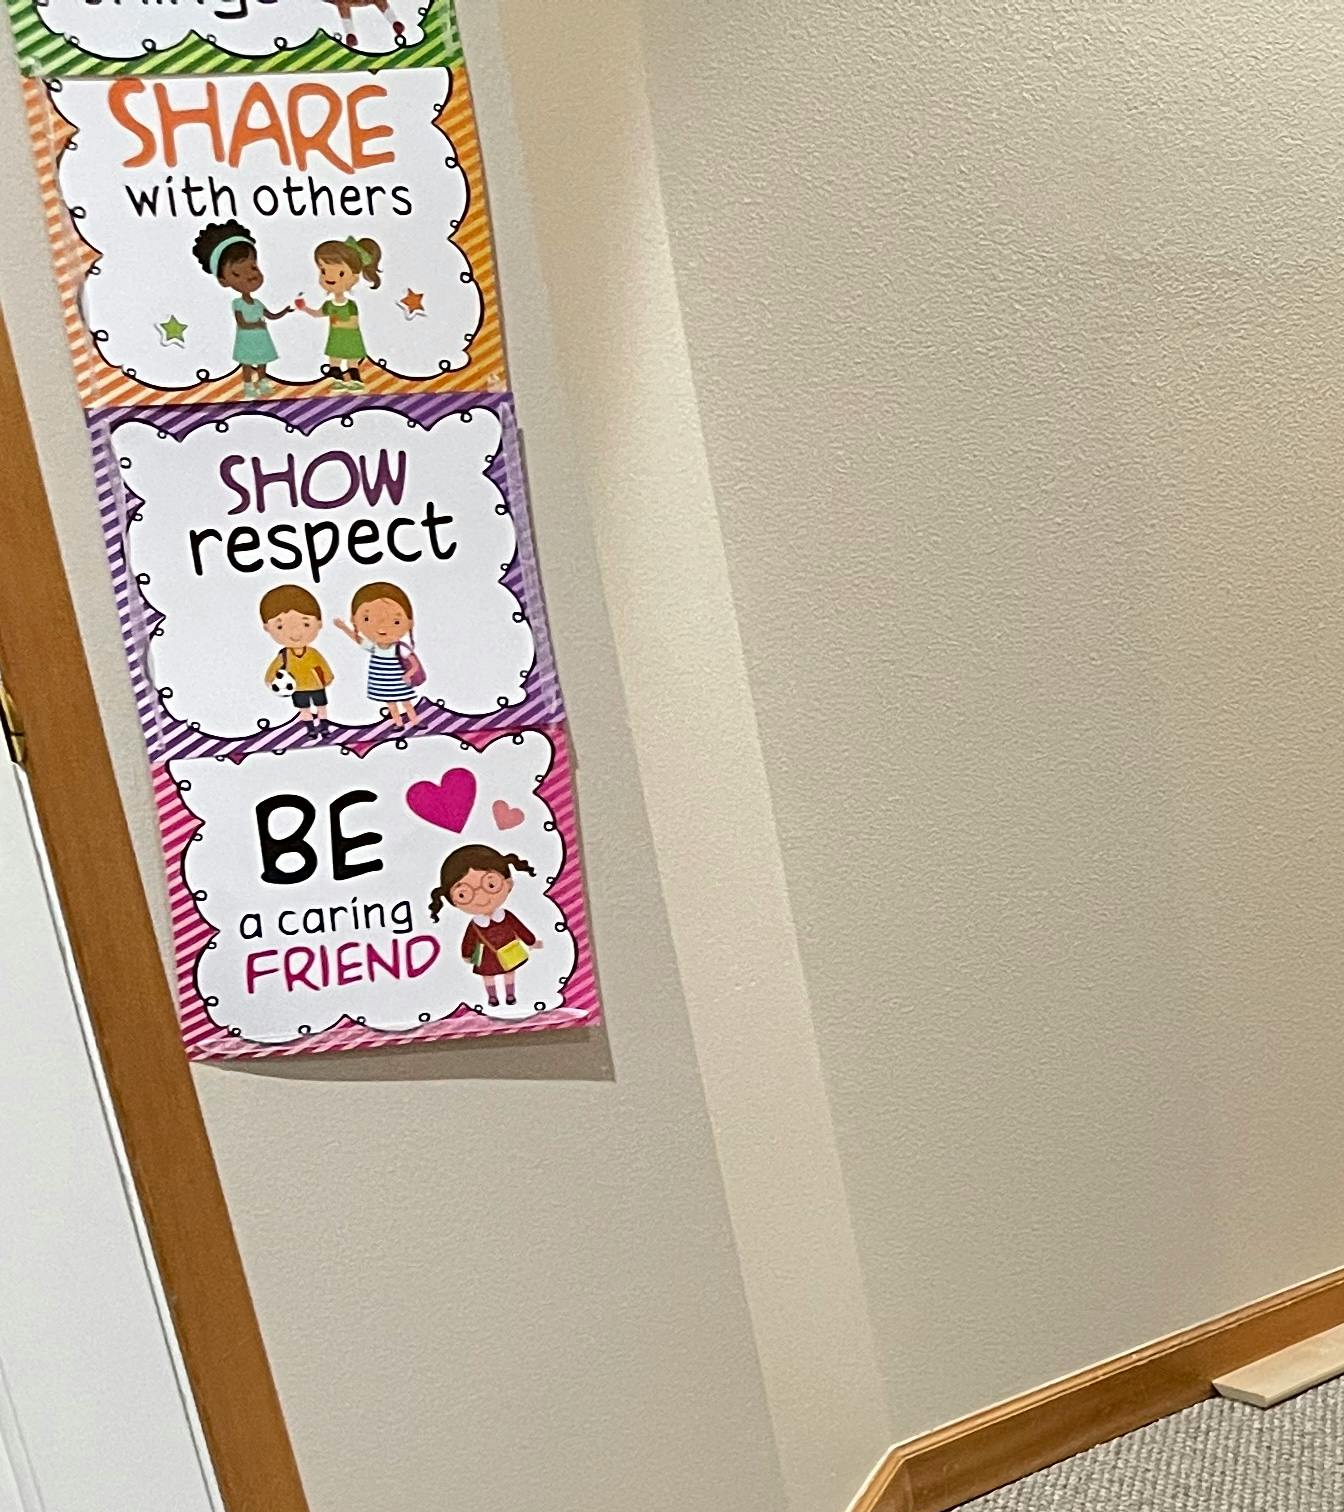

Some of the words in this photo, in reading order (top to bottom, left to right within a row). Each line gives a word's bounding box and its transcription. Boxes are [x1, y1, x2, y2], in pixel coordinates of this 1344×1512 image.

[107, 77, 395, 174] SHARE
[125, 176, 238, 218] with
[252, 176, 413, 217] others
[218, 448, 407, 515] SHOW
[189, 502, 458, 583] respect
[255, 790, 384, 885] BE
[239, 914, 262, 940] a
[277, 897, 412, 936] caring
[245, 935, 441, 995] FRIEND
